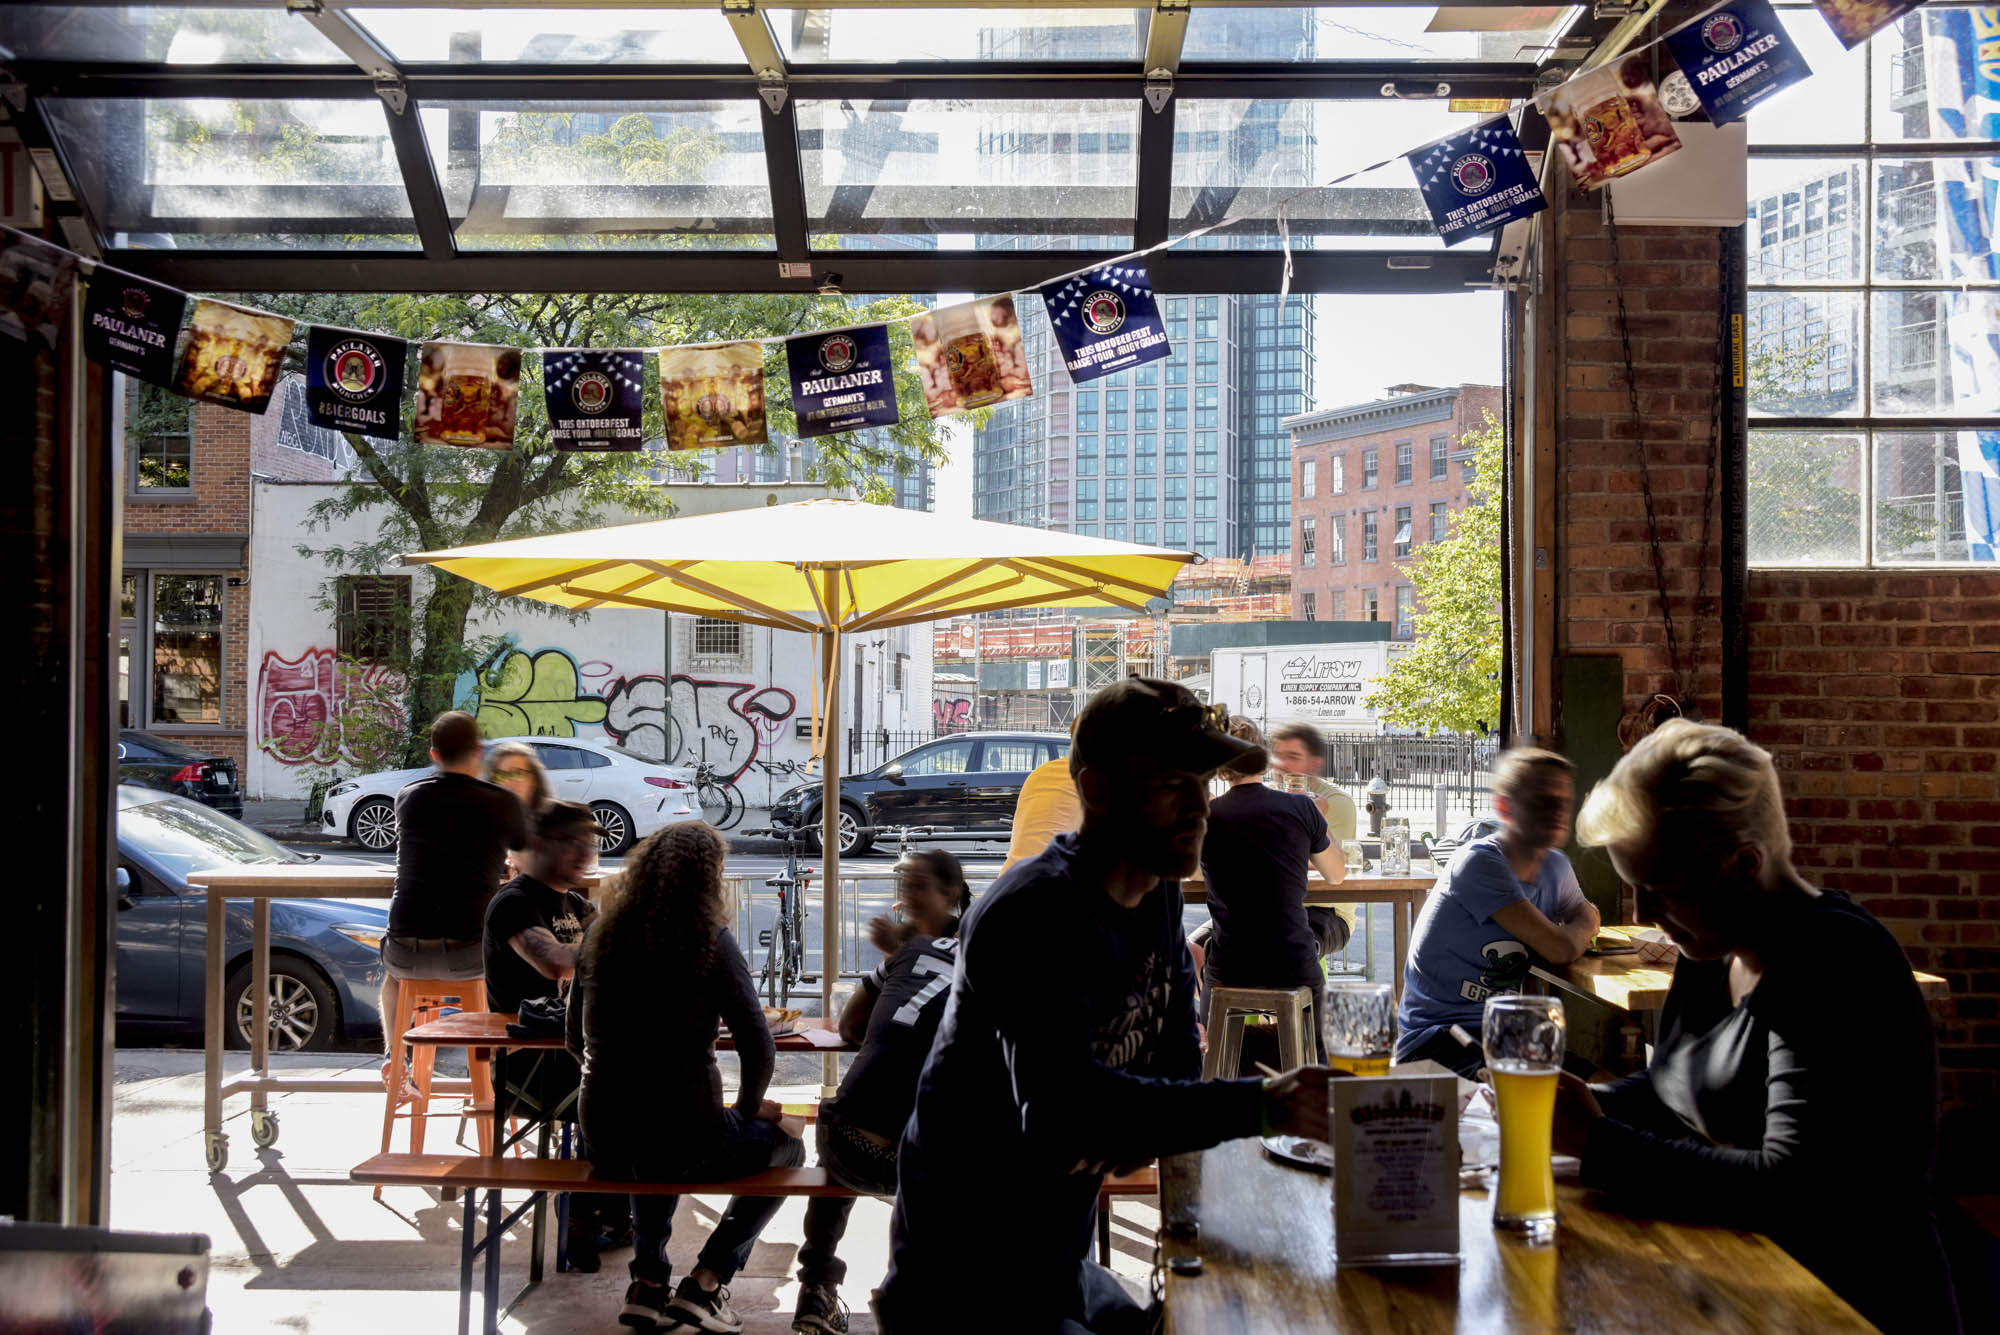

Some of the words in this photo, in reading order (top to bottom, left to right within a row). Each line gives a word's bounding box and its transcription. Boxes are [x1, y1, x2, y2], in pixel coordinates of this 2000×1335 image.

[1695, 33, 1780, 87] PAULANER
[1725, 60, 1768, 89] GERMANY'S
[1453, 155, 1488, 177] PAULANER
[1445, 207, 1467, 222] THIS
[1466, 183, 1525, 214] OKTOBERFEST
[1439, 221, 1465, 235] RAISE
[1464, 210, 1488, 225] YOUR
[1084, 292, 1118, 313] PAULANER
[92, 312, 167, 349] PAULANER
[1074, 344, 1095, 359] THIS
[1095, 325, 1151, 351] OKTOBERFEST
[1731, 322, 1740, 339] GAS
[329, 341, 382, 368] PAULANER
[1067, 357, 1093, 371] RAISE
[1092, 349, 1116, 363] YOUR
[1732, 342, 1742, 376] NATURAL
[800, 369, 884, 397] PAULANER
[822, 391, 865, 408] GERMANY'S
[318, 401, 387, 425] #BIERGOALS
[558, 419, 576, 429] THIS
[576, 417, 631, 429] OKTOBERFEST
[551, 428, 572, 439] RAISE
[571, 428, 592, 439] YOUR
[1282, 684, 1298, 692] LINEN
[1348, 683, 1360, 691] INC.
